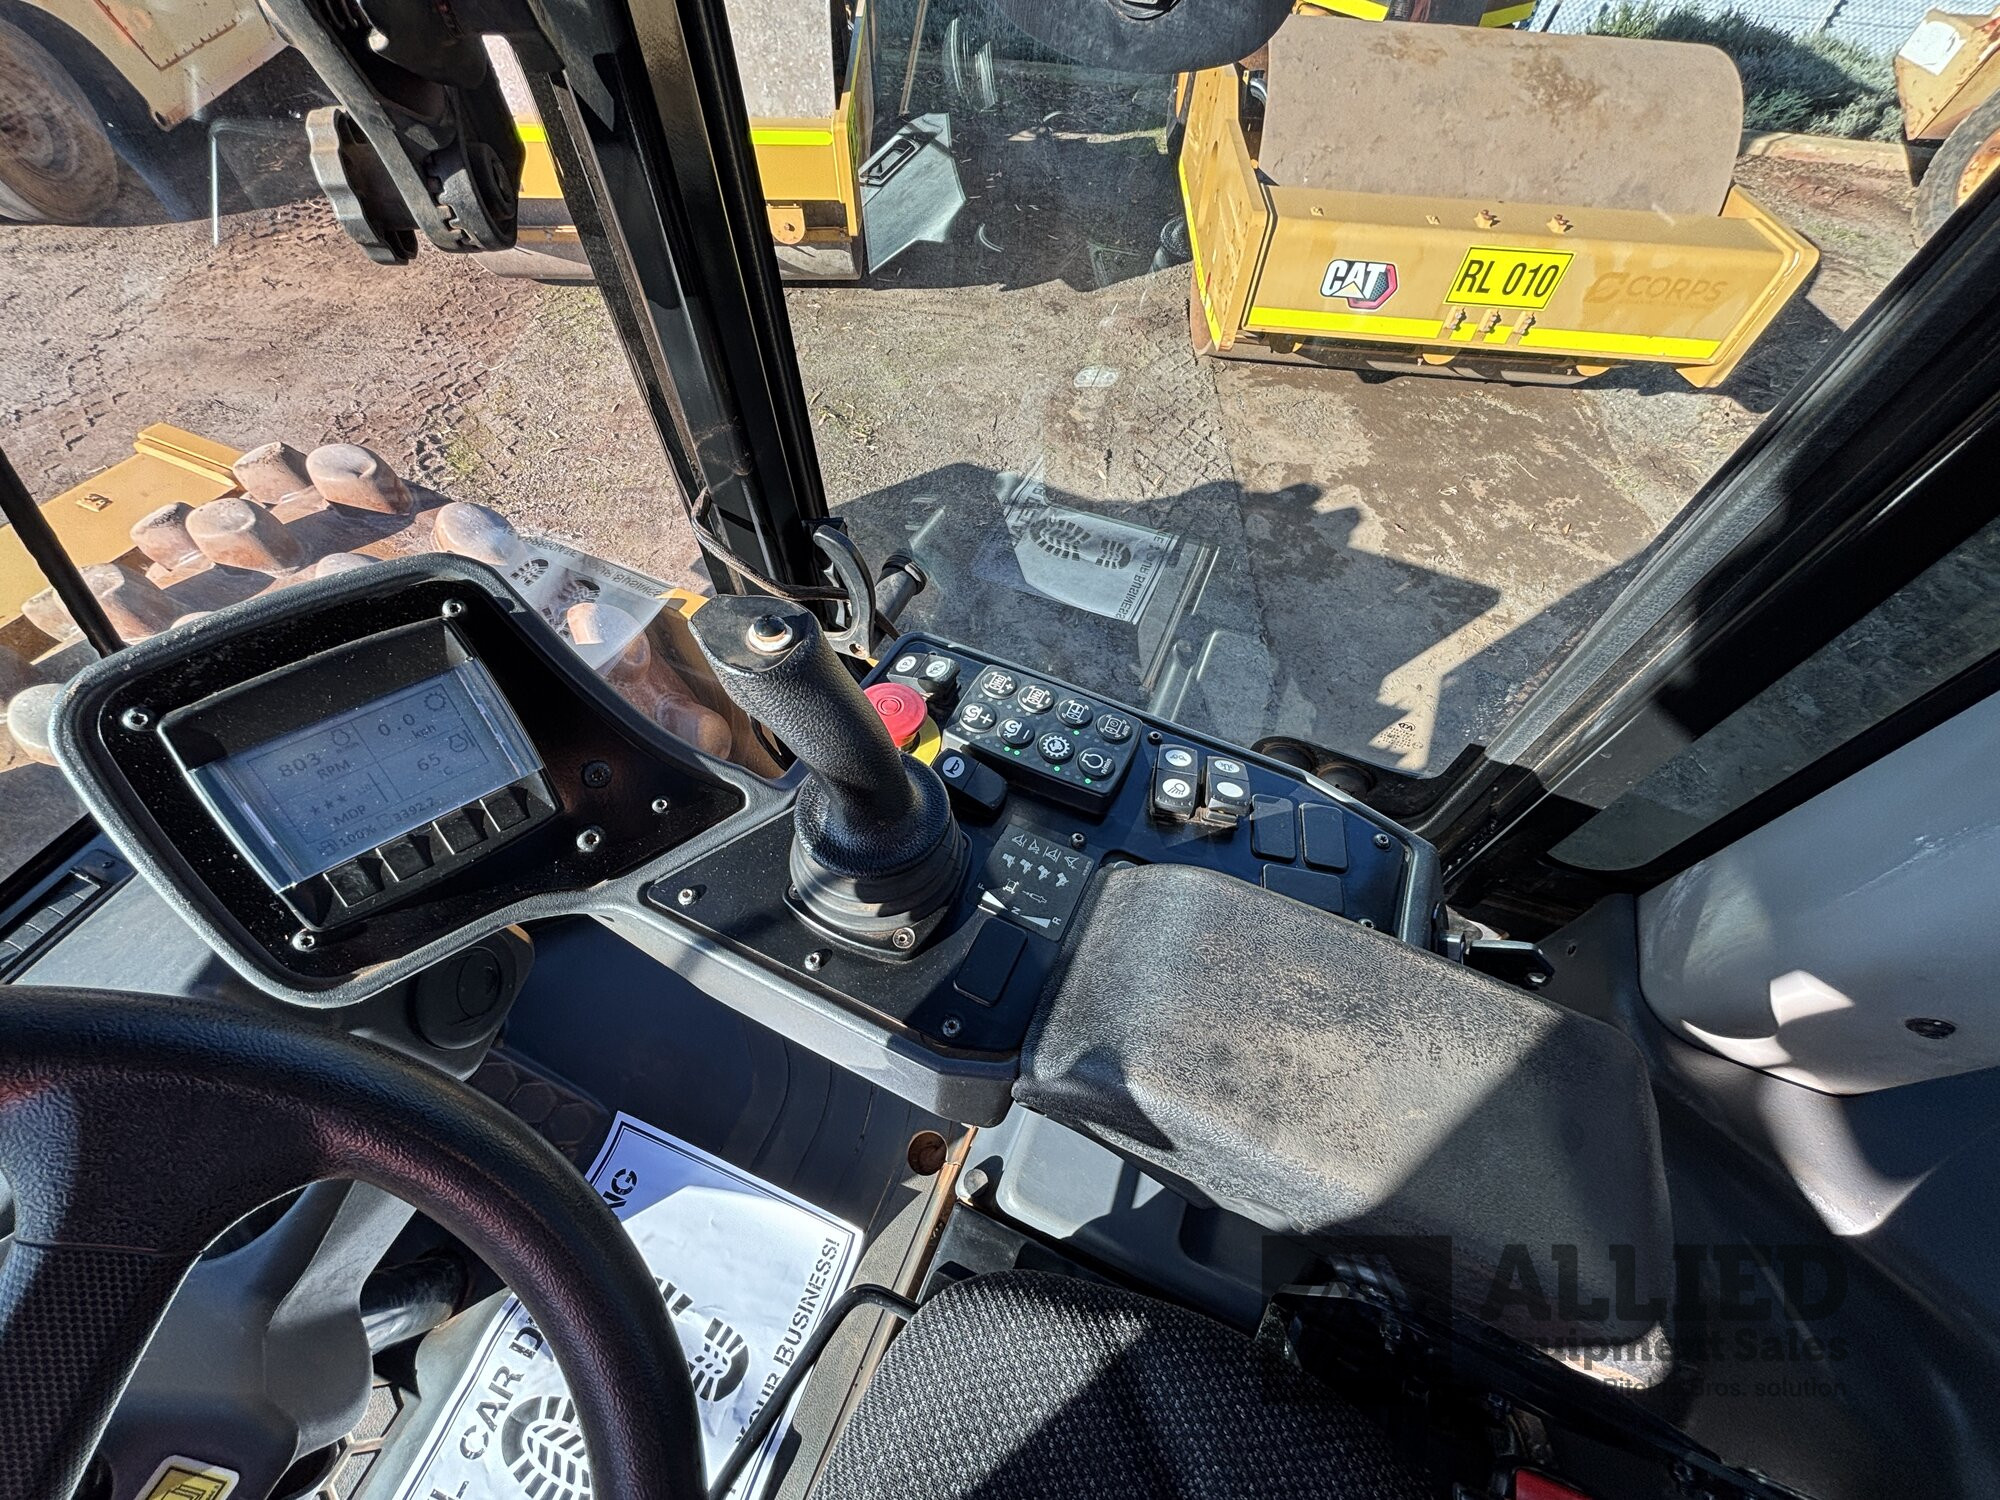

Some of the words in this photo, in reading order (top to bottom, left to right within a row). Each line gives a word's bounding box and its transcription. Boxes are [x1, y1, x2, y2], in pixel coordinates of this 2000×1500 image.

[1322, 260, 1388, 299] CAT
[1456, 260, 1496, 294] RL
[1502, 262, 1560, 298] 010
[1623, 275, 1729, 301] CORPS
[378, 713, 415, 737] 0.0
[277, 752, 321, 778] 803
[317, 759, 352, 781] RPM
[417, 752, 441, 771] 65
[333, 805, 367, 826] MDP
[338, 824, 377, 848] 100%
[1011, 906, 1021, 916] N
[1052, 916, 1062, 925] R
[773, 1238, 840, 1367] BUSINESS!
[460, 1365, 525, 1461] CAR
